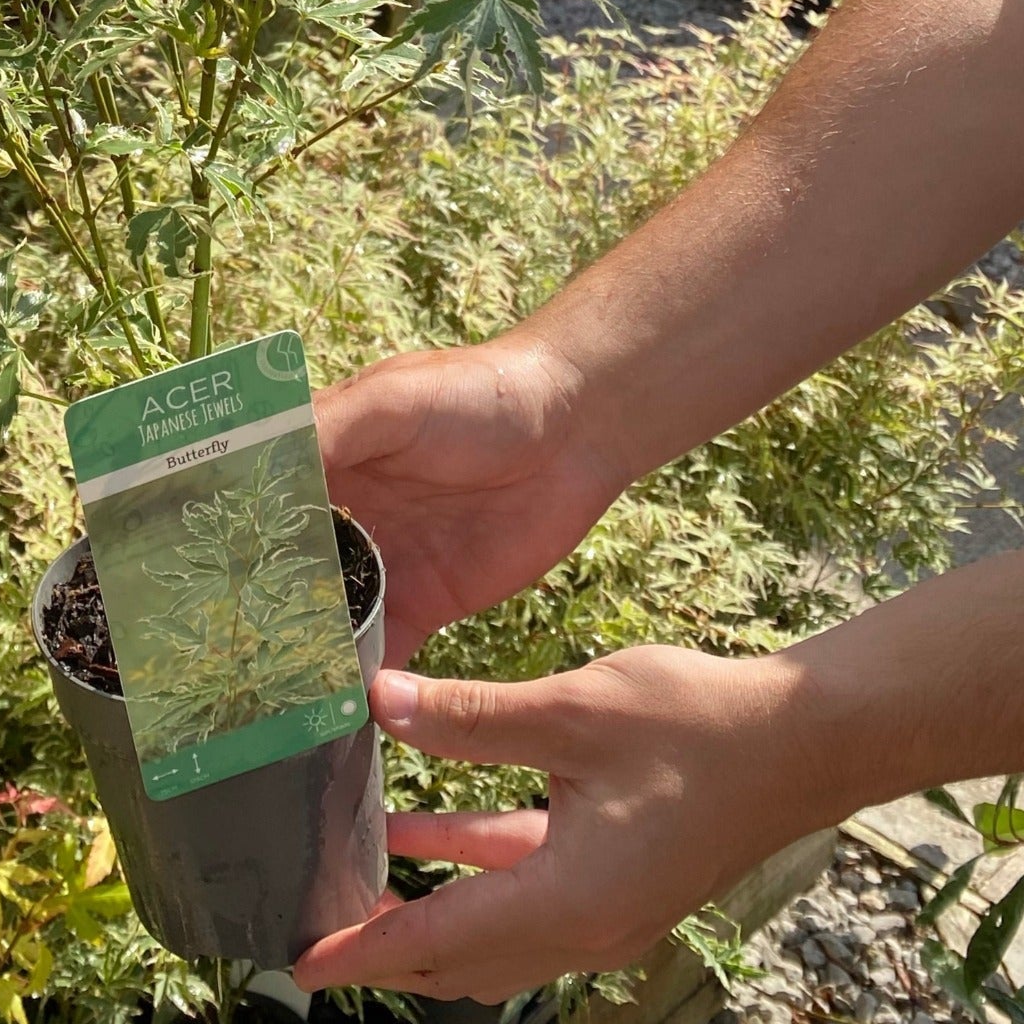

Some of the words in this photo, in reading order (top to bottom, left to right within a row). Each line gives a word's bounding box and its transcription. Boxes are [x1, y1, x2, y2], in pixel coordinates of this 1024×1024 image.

[138, 409, 199, 447] JAPANESE
[200, 393, 244, 425] JEWELS
[142, 370, 233, 422] ACER
[166, 440, 230, 469] Butterfly
